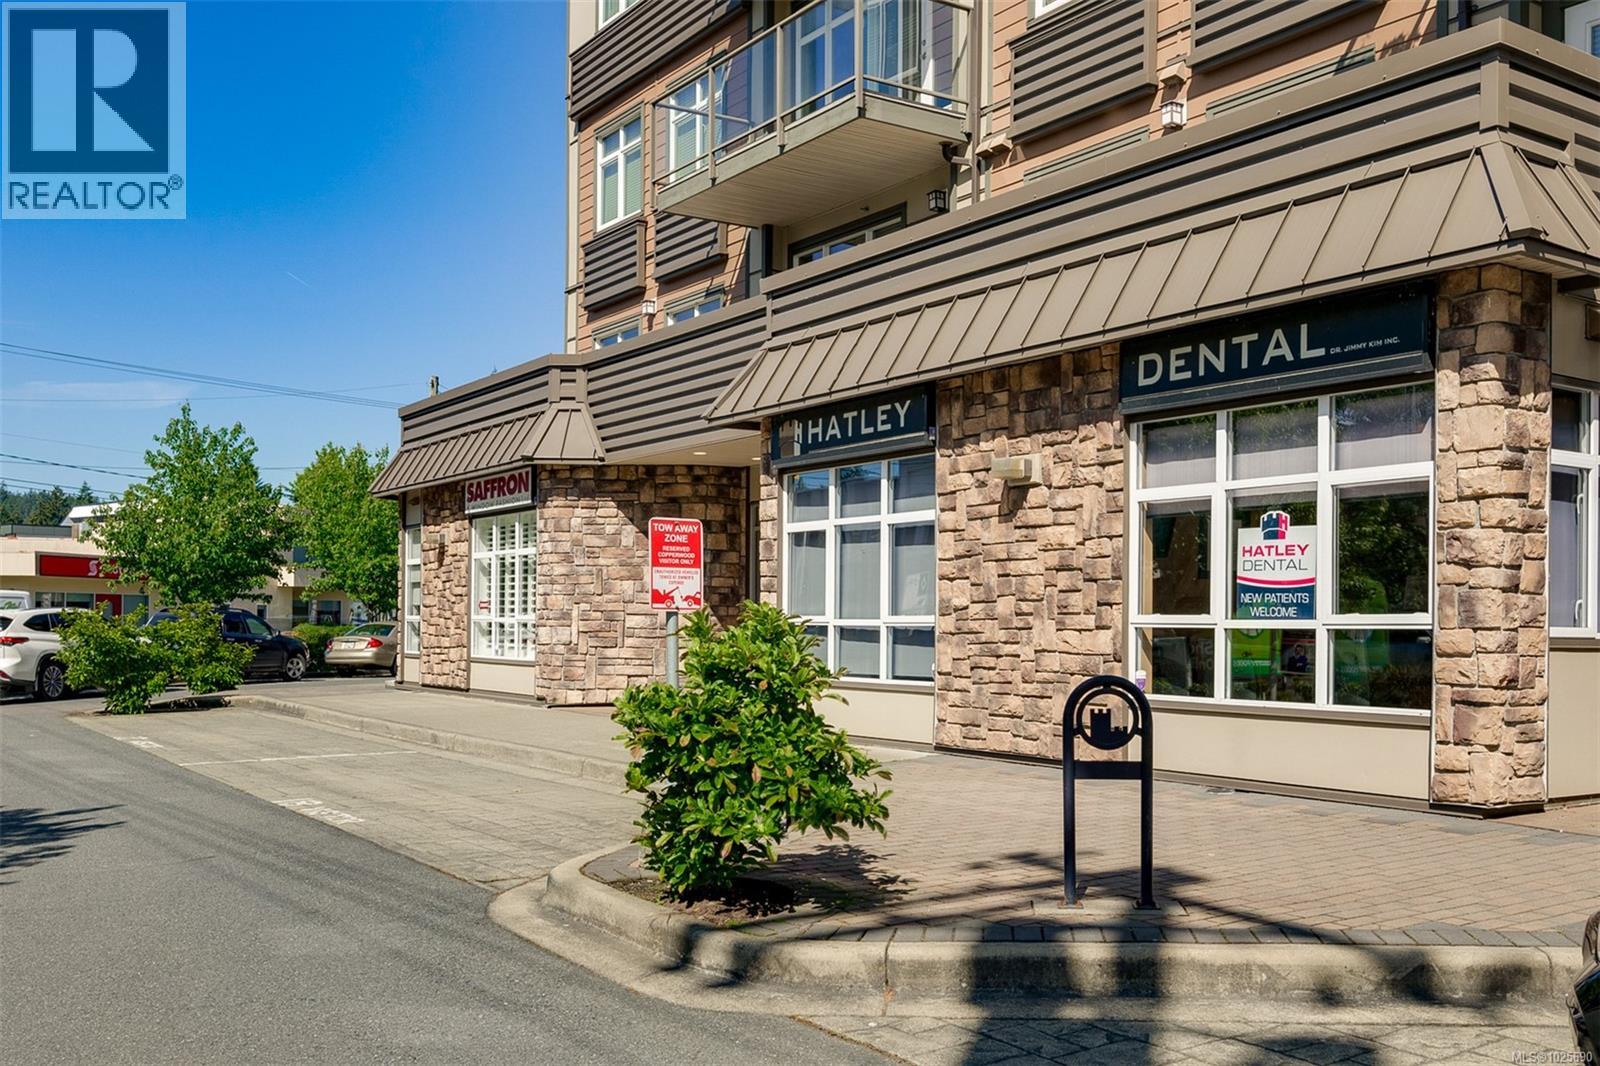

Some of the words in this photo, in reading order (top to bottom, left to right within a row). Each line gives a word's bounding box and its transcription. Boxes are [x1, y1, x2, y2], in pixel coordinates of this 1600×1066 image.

[1329, 346, 1343, 354] DR.
[1343, 342, 1367, 352] JIMMY
[1368, 339, 1383, 348] KIM
[1383, 336, 1401, 345] INC.
[1137, 323, 1326, 387] DENTAL
[808, 400, 912, 444] HATLEY
[466, 469, 530, 503] SAFFRON
[653, 523, 673, 532] TOW
[675, 525, 699, 534] AWAY
[664, 534, 688, 543] ZONE
[1241, 544, 1310, 558] HATLEY
[1242, 558, 1309, 572] DENTAL
[1240, 592, 1262, 603] NEW
[1264, 592, 1310, 603] PATIENTS
[1249, 606, 1298, 618] WELCOME
